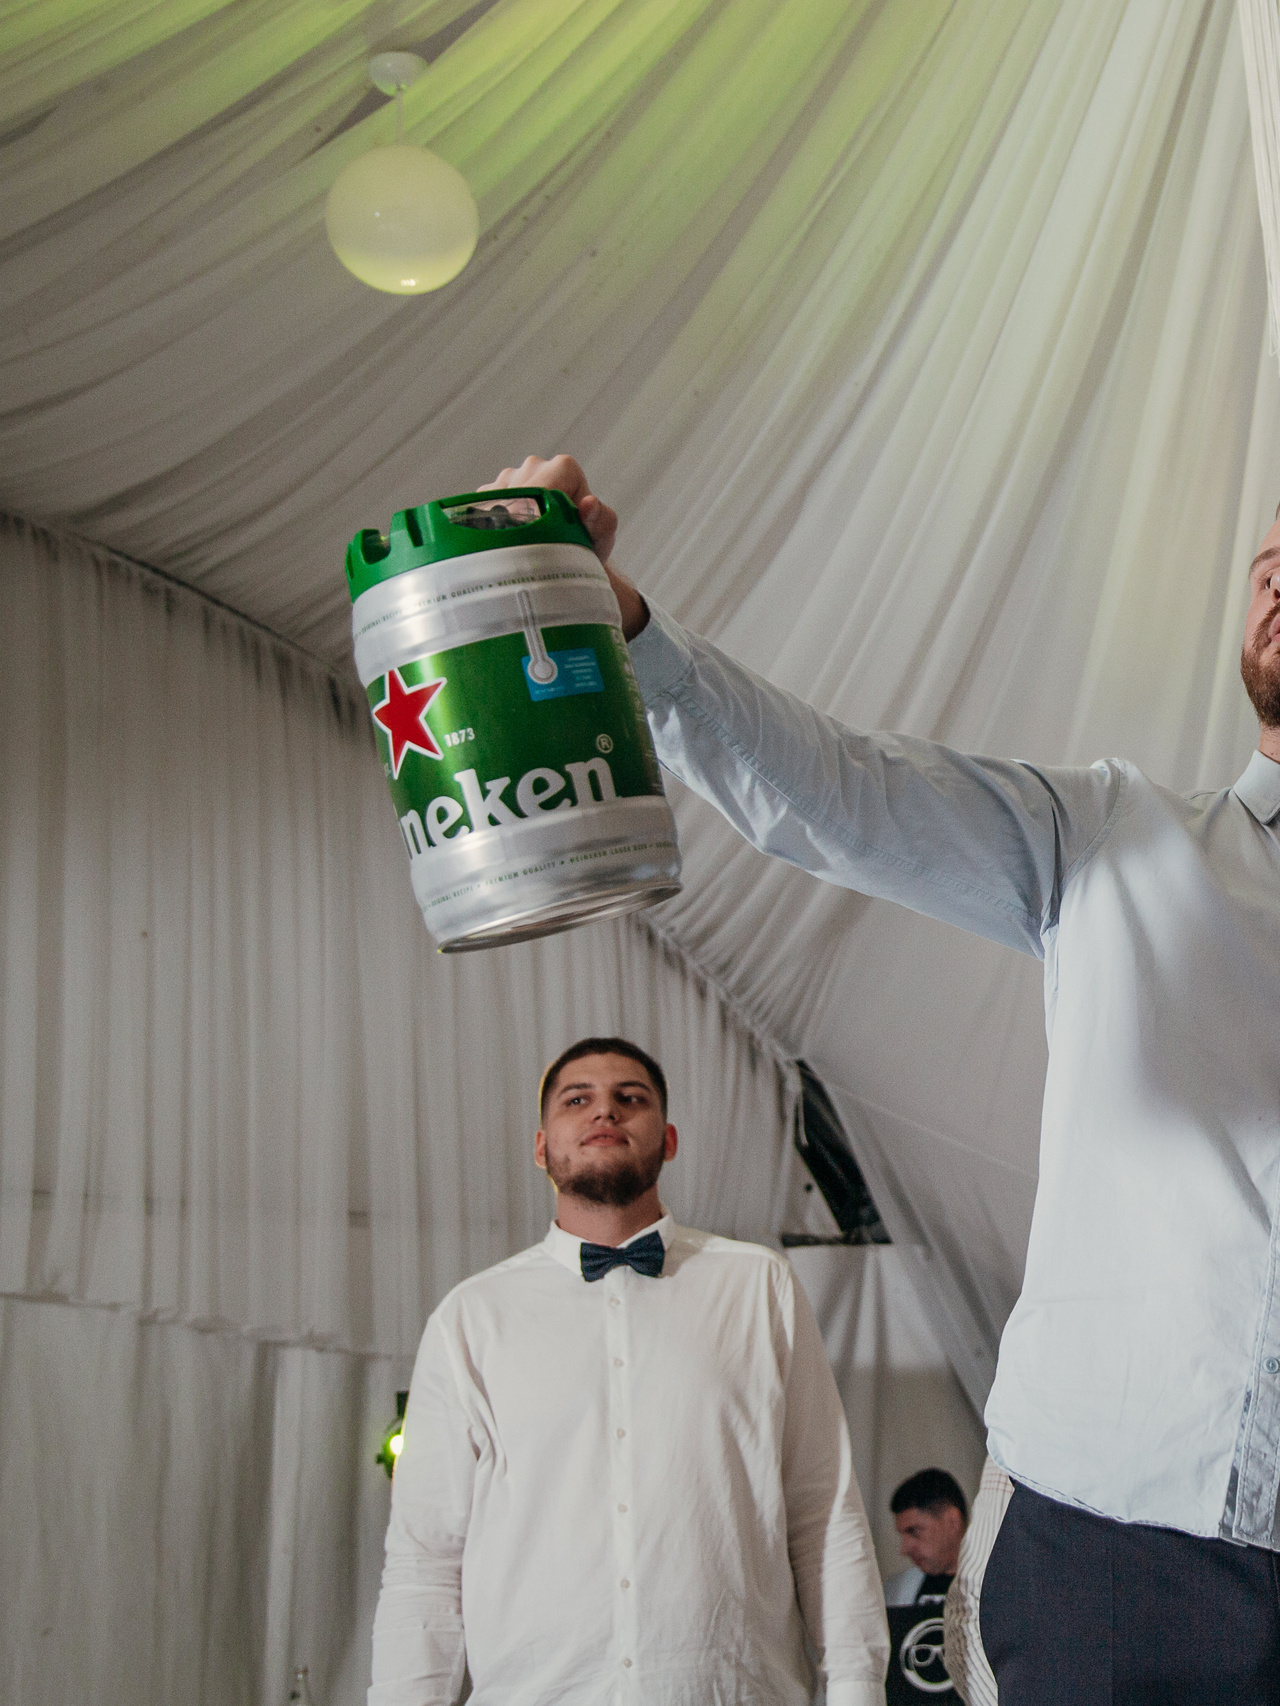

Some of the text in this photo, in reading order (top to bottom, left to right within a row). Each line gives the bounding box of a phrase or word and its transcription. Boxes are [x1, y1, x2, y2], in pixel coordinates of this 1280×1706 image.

[450, 584, 484, 598] QUALITY
[443, 727, 476, 748] 1873
[397, 756, 621, 860] neken
[485, 871, 520, 886] PREMIUM
[522, 861, 556, 876] QUALITY
